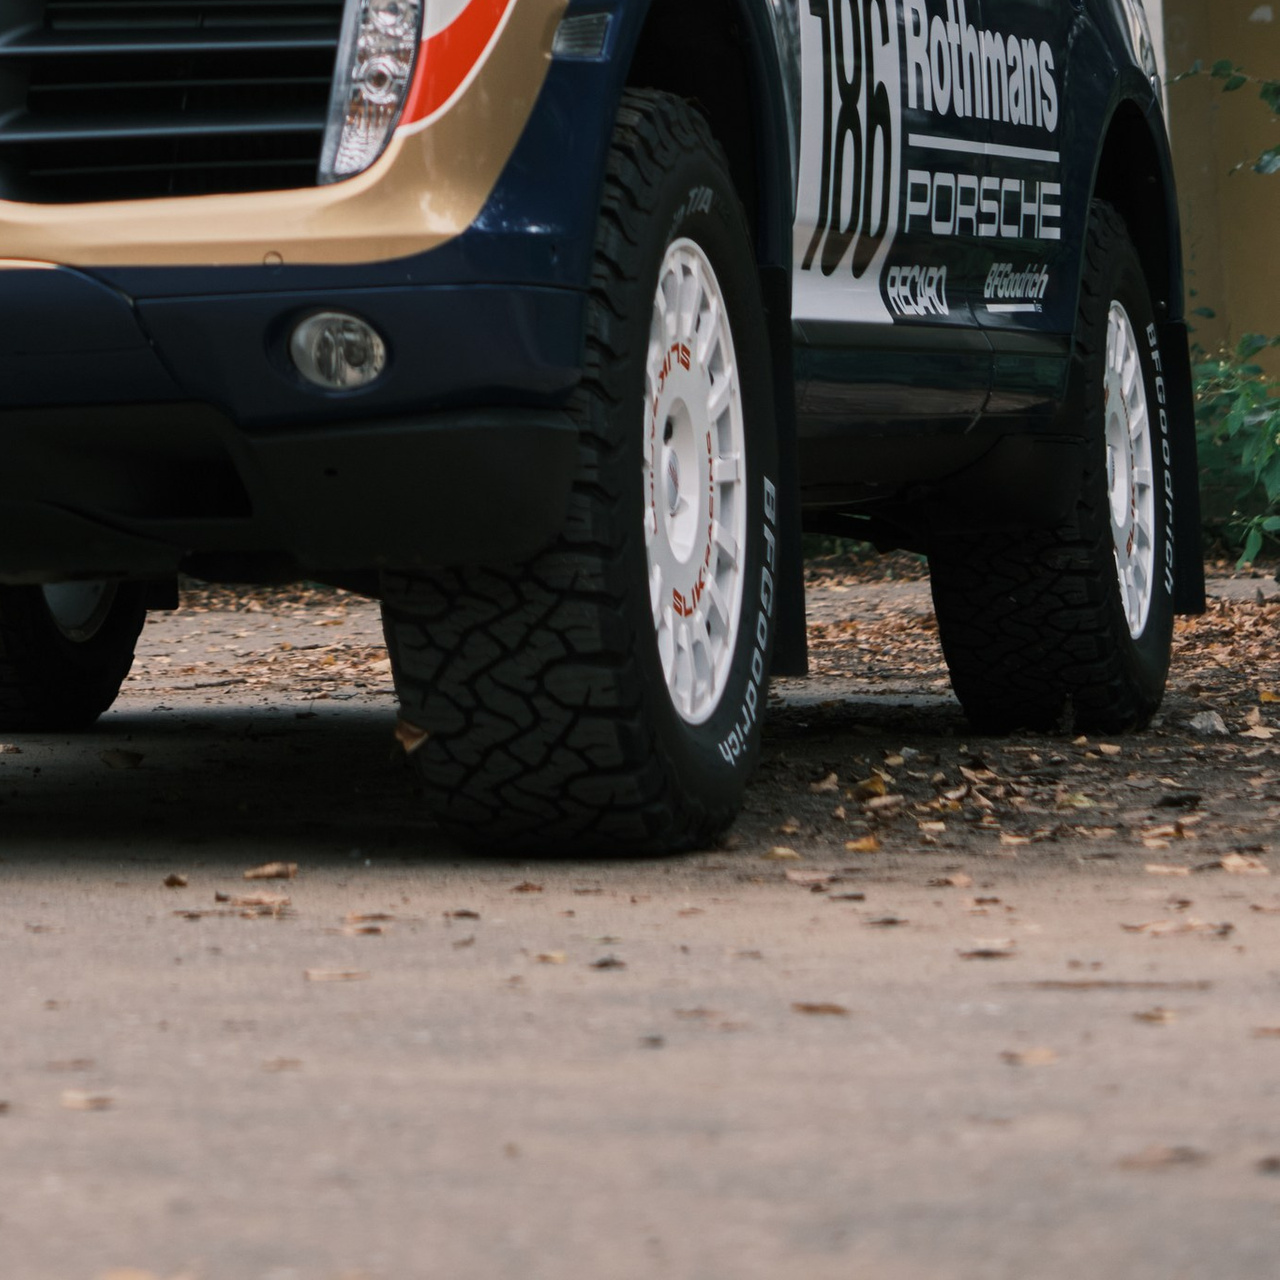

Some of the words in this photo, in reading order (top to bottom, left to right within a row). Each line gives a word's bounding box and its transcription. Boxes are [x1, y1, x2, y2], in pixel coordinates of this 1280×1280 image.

[904, 169, 1061, 240] PORSCHE
[887, 264, 949, 316] RECARO
[984, 263, 1049, 299] BFGoodrich
[1146, 322, 1175, 596] BFGoodrich
[719, 476, 776, 767] BFGoodrich
